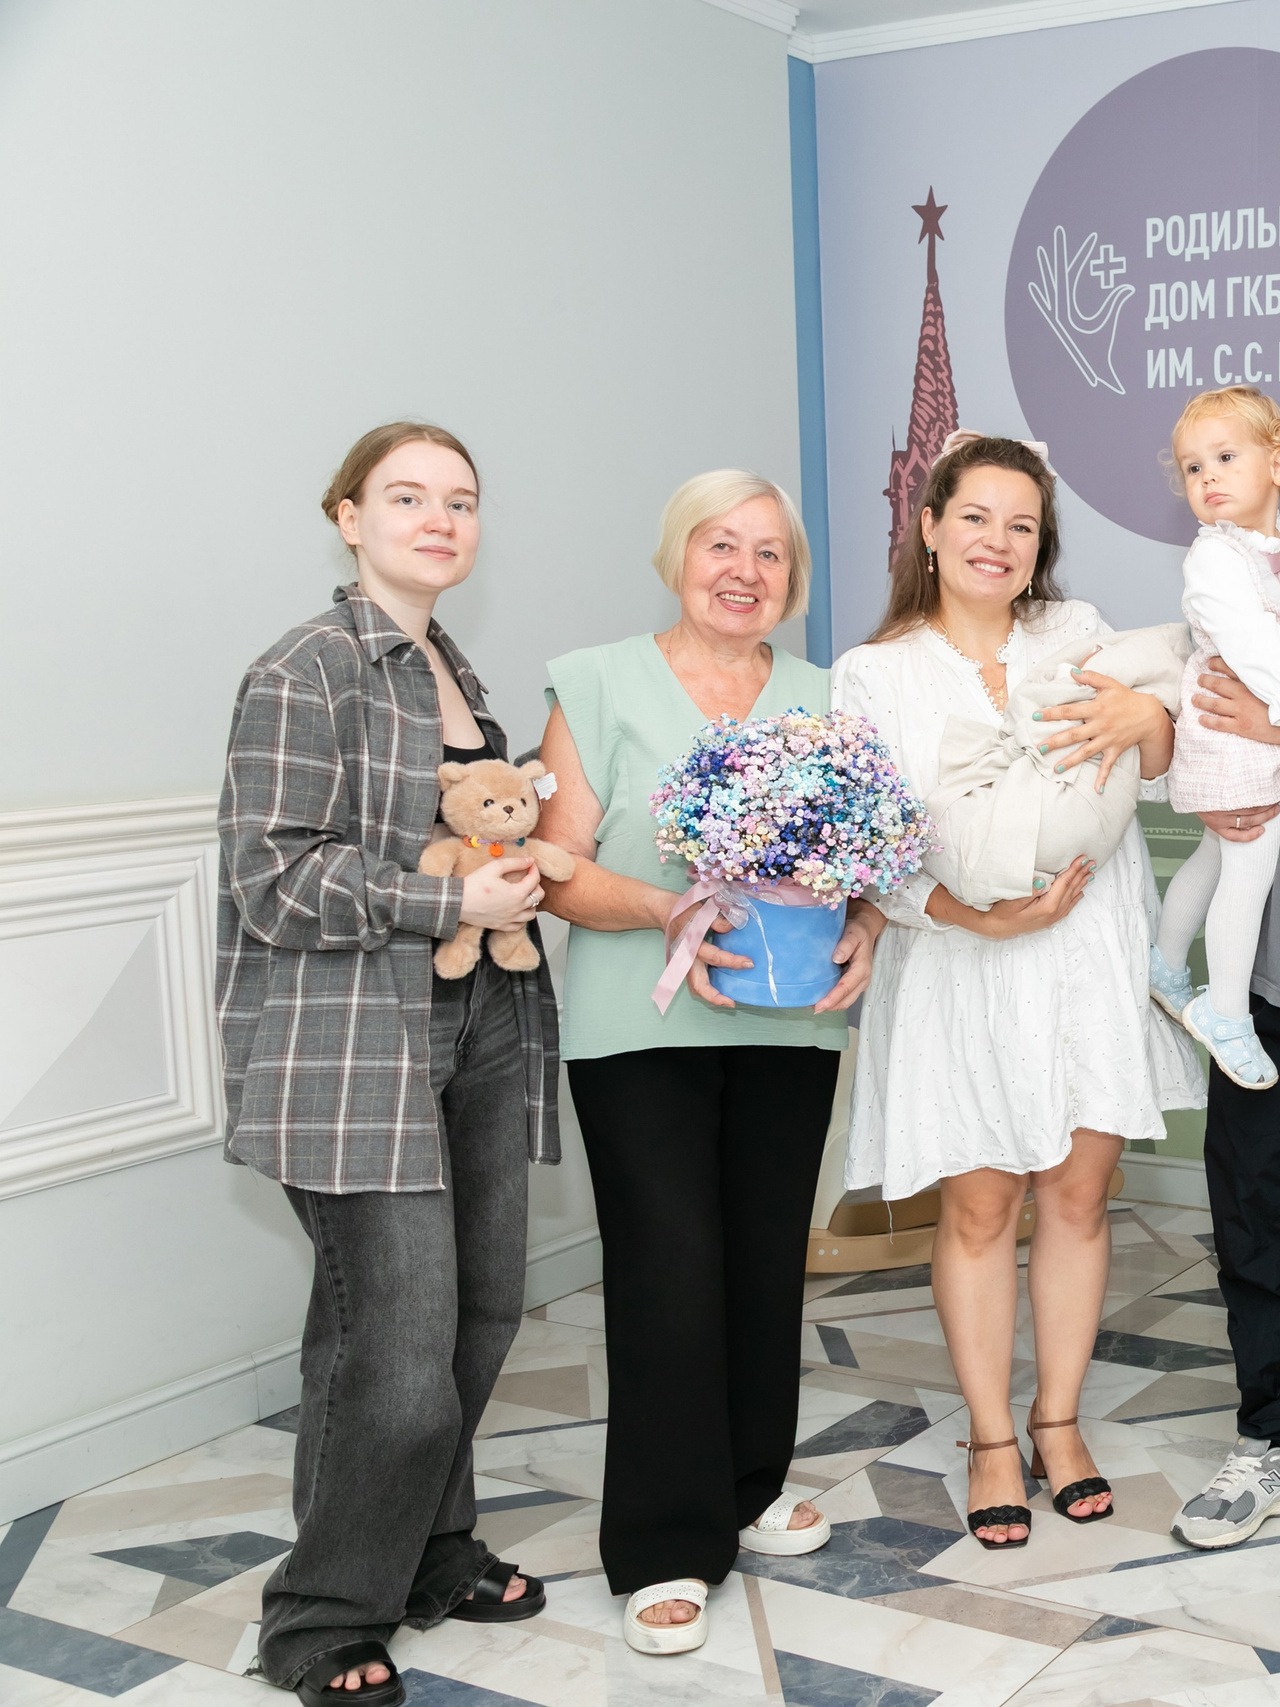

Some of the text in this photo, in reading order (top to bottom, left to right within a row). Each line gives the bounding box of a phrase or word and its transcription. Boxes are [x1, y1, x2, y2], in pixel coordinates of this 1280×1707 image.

[1144, 278, 1215, 332] ДОМ
[1146, 346, 1203, 389] ИМ.
[1213, 341, 1272, 385] С.С.
